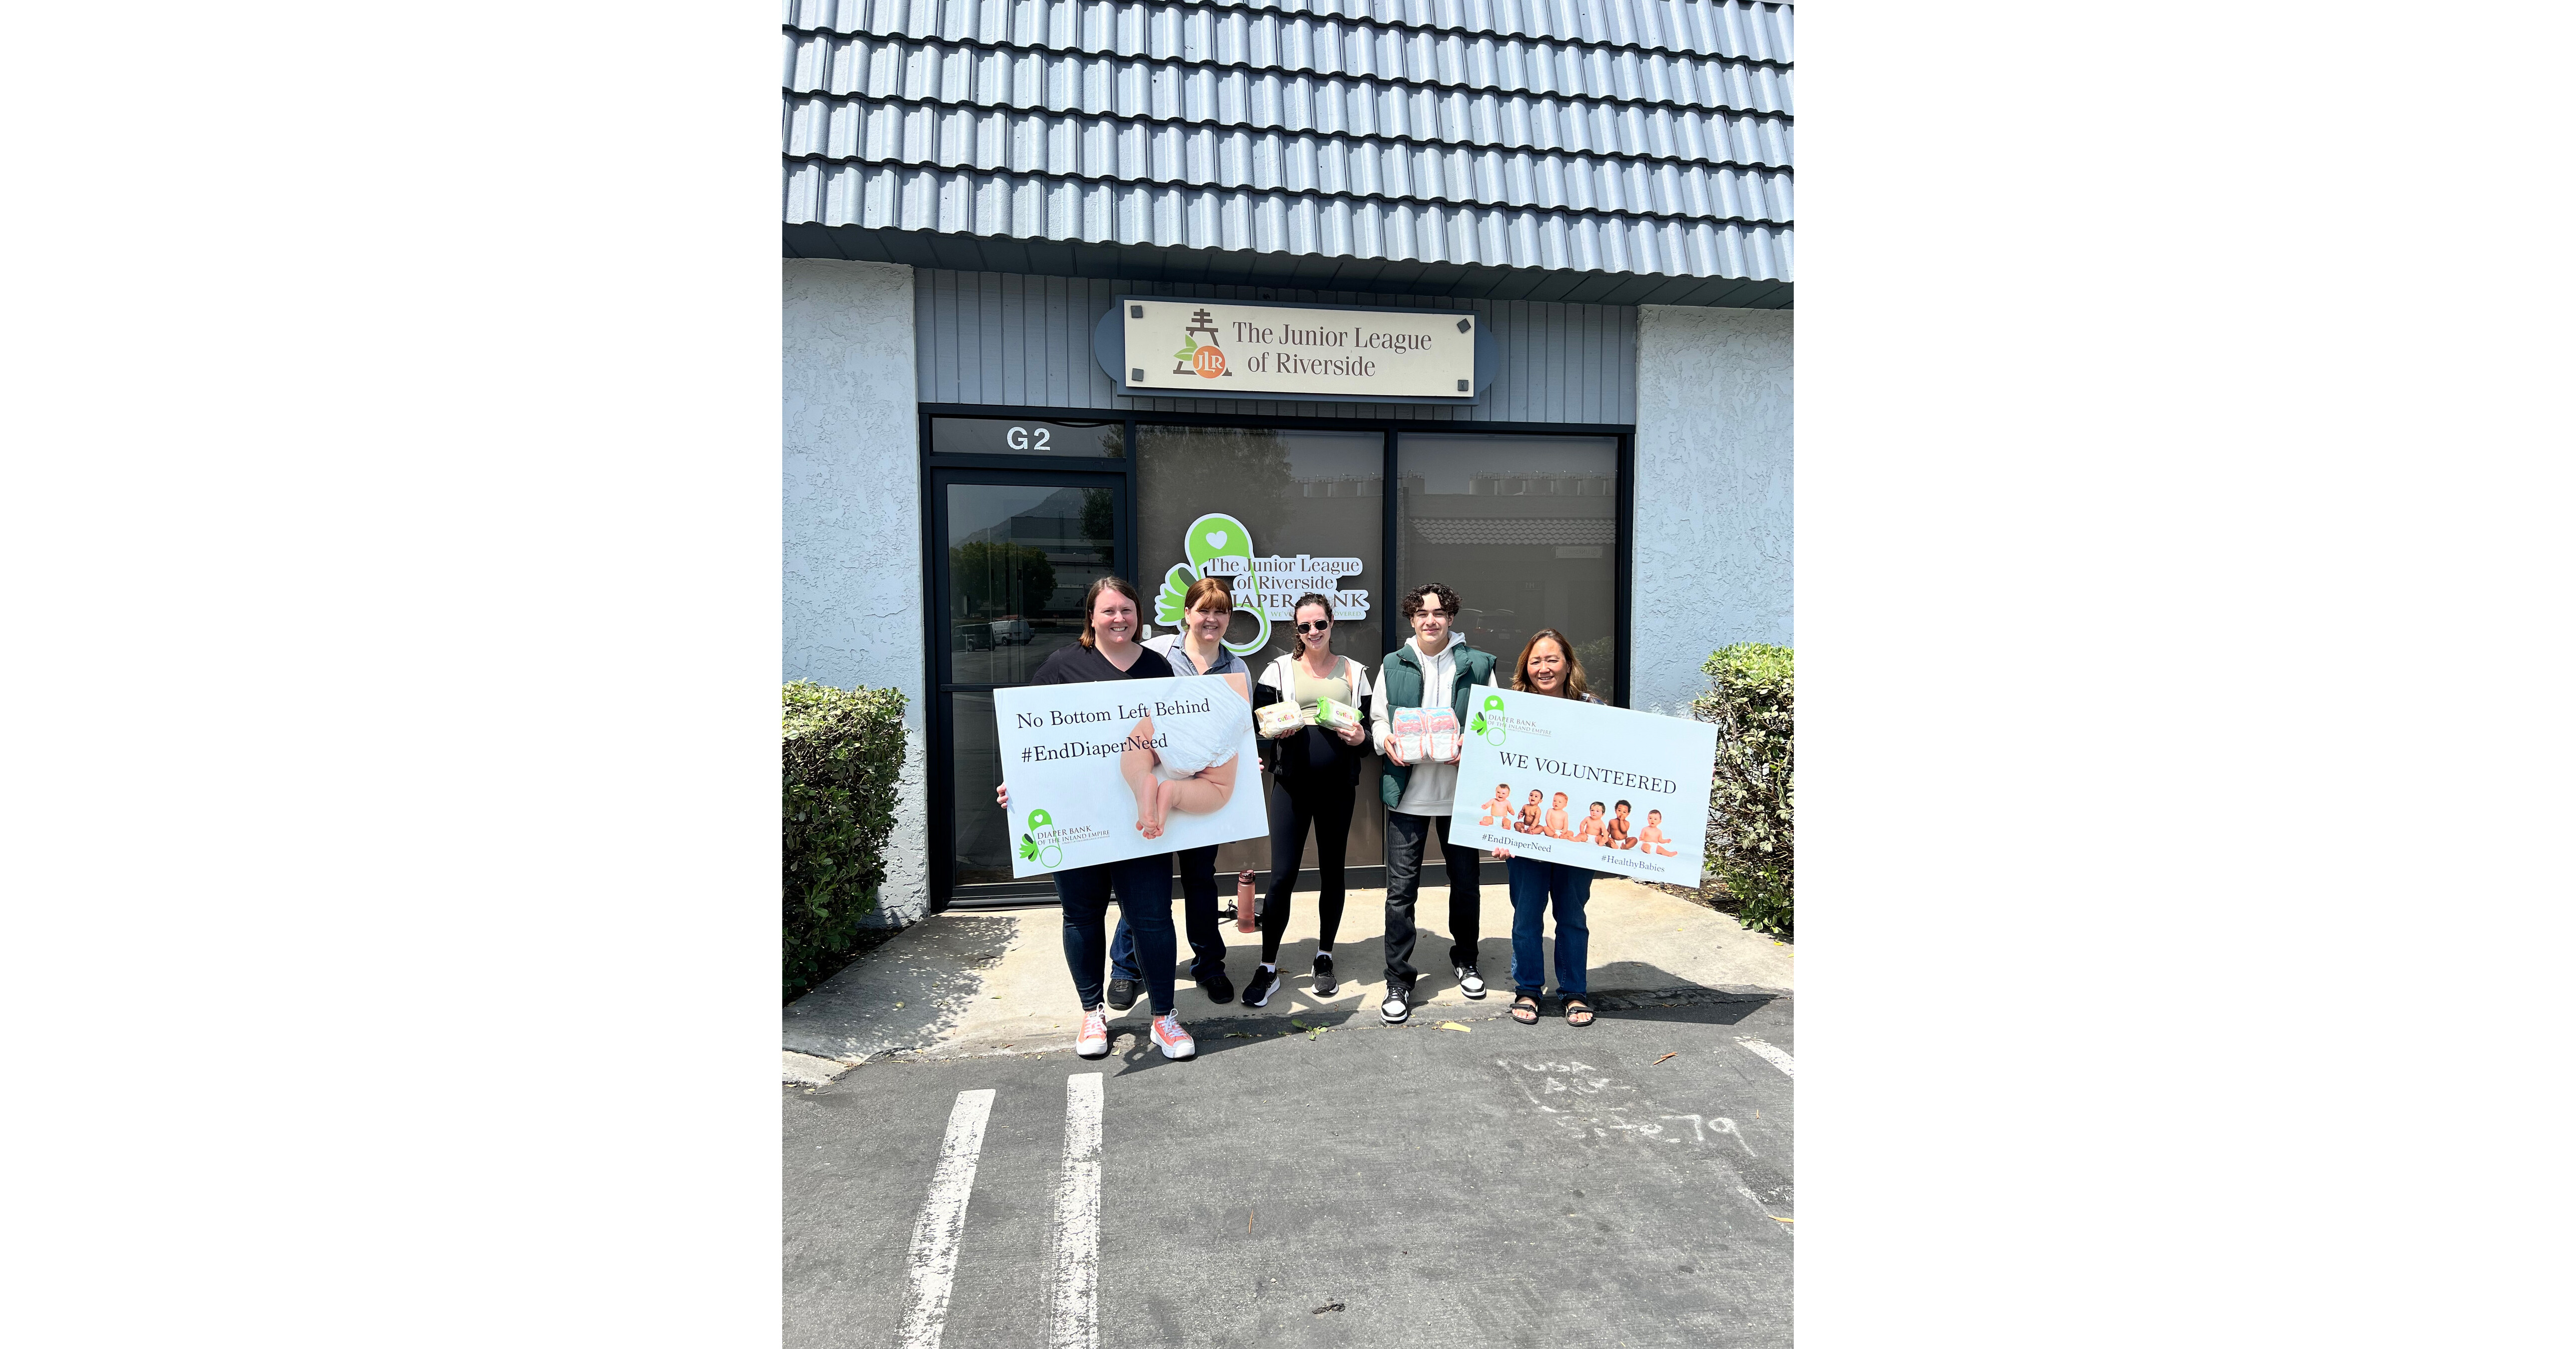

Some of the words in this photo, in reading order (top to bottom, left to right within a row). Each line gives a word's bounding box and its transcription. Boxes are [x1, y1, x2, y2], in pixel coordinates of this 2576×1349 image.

[1233, 321, 1273, 345] The
[1279, 324, 1348, 348] Junior
[1354, 326, 1432, 354] League
[1193, 351, 1223, 373] JLR
[1248, 352, 1269, 374] of
[1277, 353, 1376, 377] Riverside
[1007, 426, 1050, 451] G2
[1208, 558, 1239, 572] The
[1244, 558, 1296, 572] Junior
[1301, 558, 1360, 575] League
[1237, 576, 1253, 589] of
[1259, 576, 1334, 590] Riverside
[1232, 594, 1296, 608] IAPER
[1303, 592, 1366, 607] NK
[1017, 713, 1043, 728] No
[1051, 709, 1111, 726] Bottom
[1118, 703, 1150, 720] Left
[1155, 698, 1211, 716] Behind
[1336, 710, 1352, 720] cuties
[1489, 714, 1515, 723] DIAPER
[1517, 719, 1537, 727] BANK
[1021, 733, 1168, 762] #EndDiaperNeed
[1499, 751, 1529, 769] WE
[1535, 757, 1677, 794] VOLUNTEERED
[1037, 829, 1067, 839] DIAPER
[1069, 825, 1092, 834] BANK
[1062, 833, 1086, 842] INLAND
[1482, 834, 1551, 853] #EndDiaperNeed
[1601, 854, 1665, 873] #HealthyBabies
